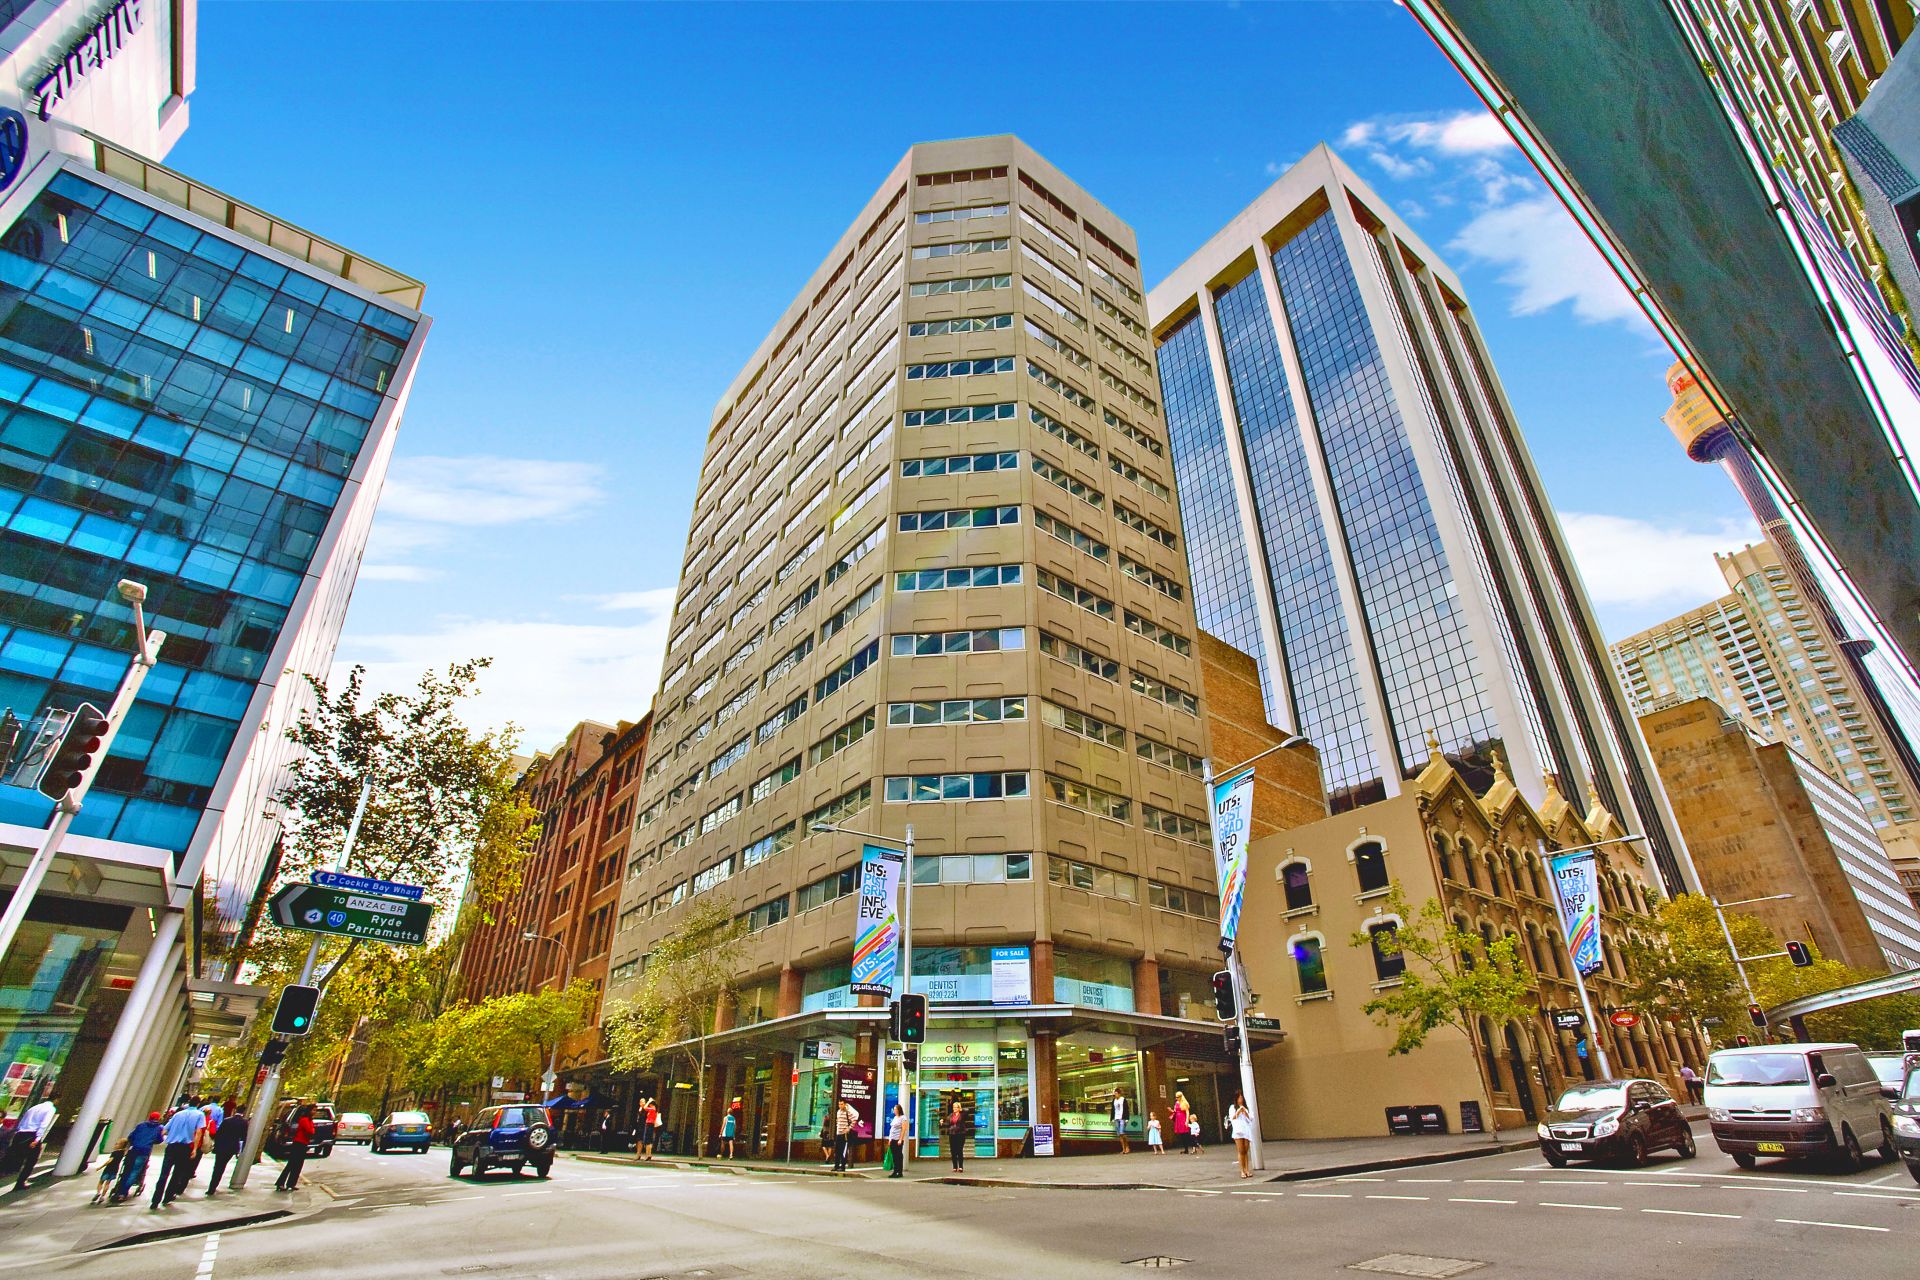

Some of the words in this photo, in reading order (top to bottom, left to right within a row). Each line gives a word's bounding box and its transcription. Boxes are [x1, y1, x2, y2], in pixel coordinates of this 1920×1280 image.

[1218, 795, 1241, 815] UTS:
[865, 861, 887, 878] UTS:
[1558, 867, 1584, 879] UTS:
[339, 877, 369, 888] Cockle
[372, 882, 390, 893] Bay
[393, 886, 420, 896] Wharf
[1560, 875, 1586, 890] POST
[1562, 883, 1590, 898] GRAD
[333, 896, 346, 904] TO
[350, 899, 386, 911] ANZAC
[390, 905, 404, 913] BR
[1564, 893, 1586, 908] INFO
[308, 911, 318, 920] 4
[330, 913, 343, 923] 40
[370, 914, 402, 927] Ryde
[860, 906, 884, 920] EVE
[346, 922, 420, 941] Parramatta
[853, 956, 879, 978] UTS:
[929, 980, 958, 990] DENTIST
[945, 1043, 968, 1055] city
[973, 1054, 993, 1062] store
[1072, 1117, 1085, 1127] city
